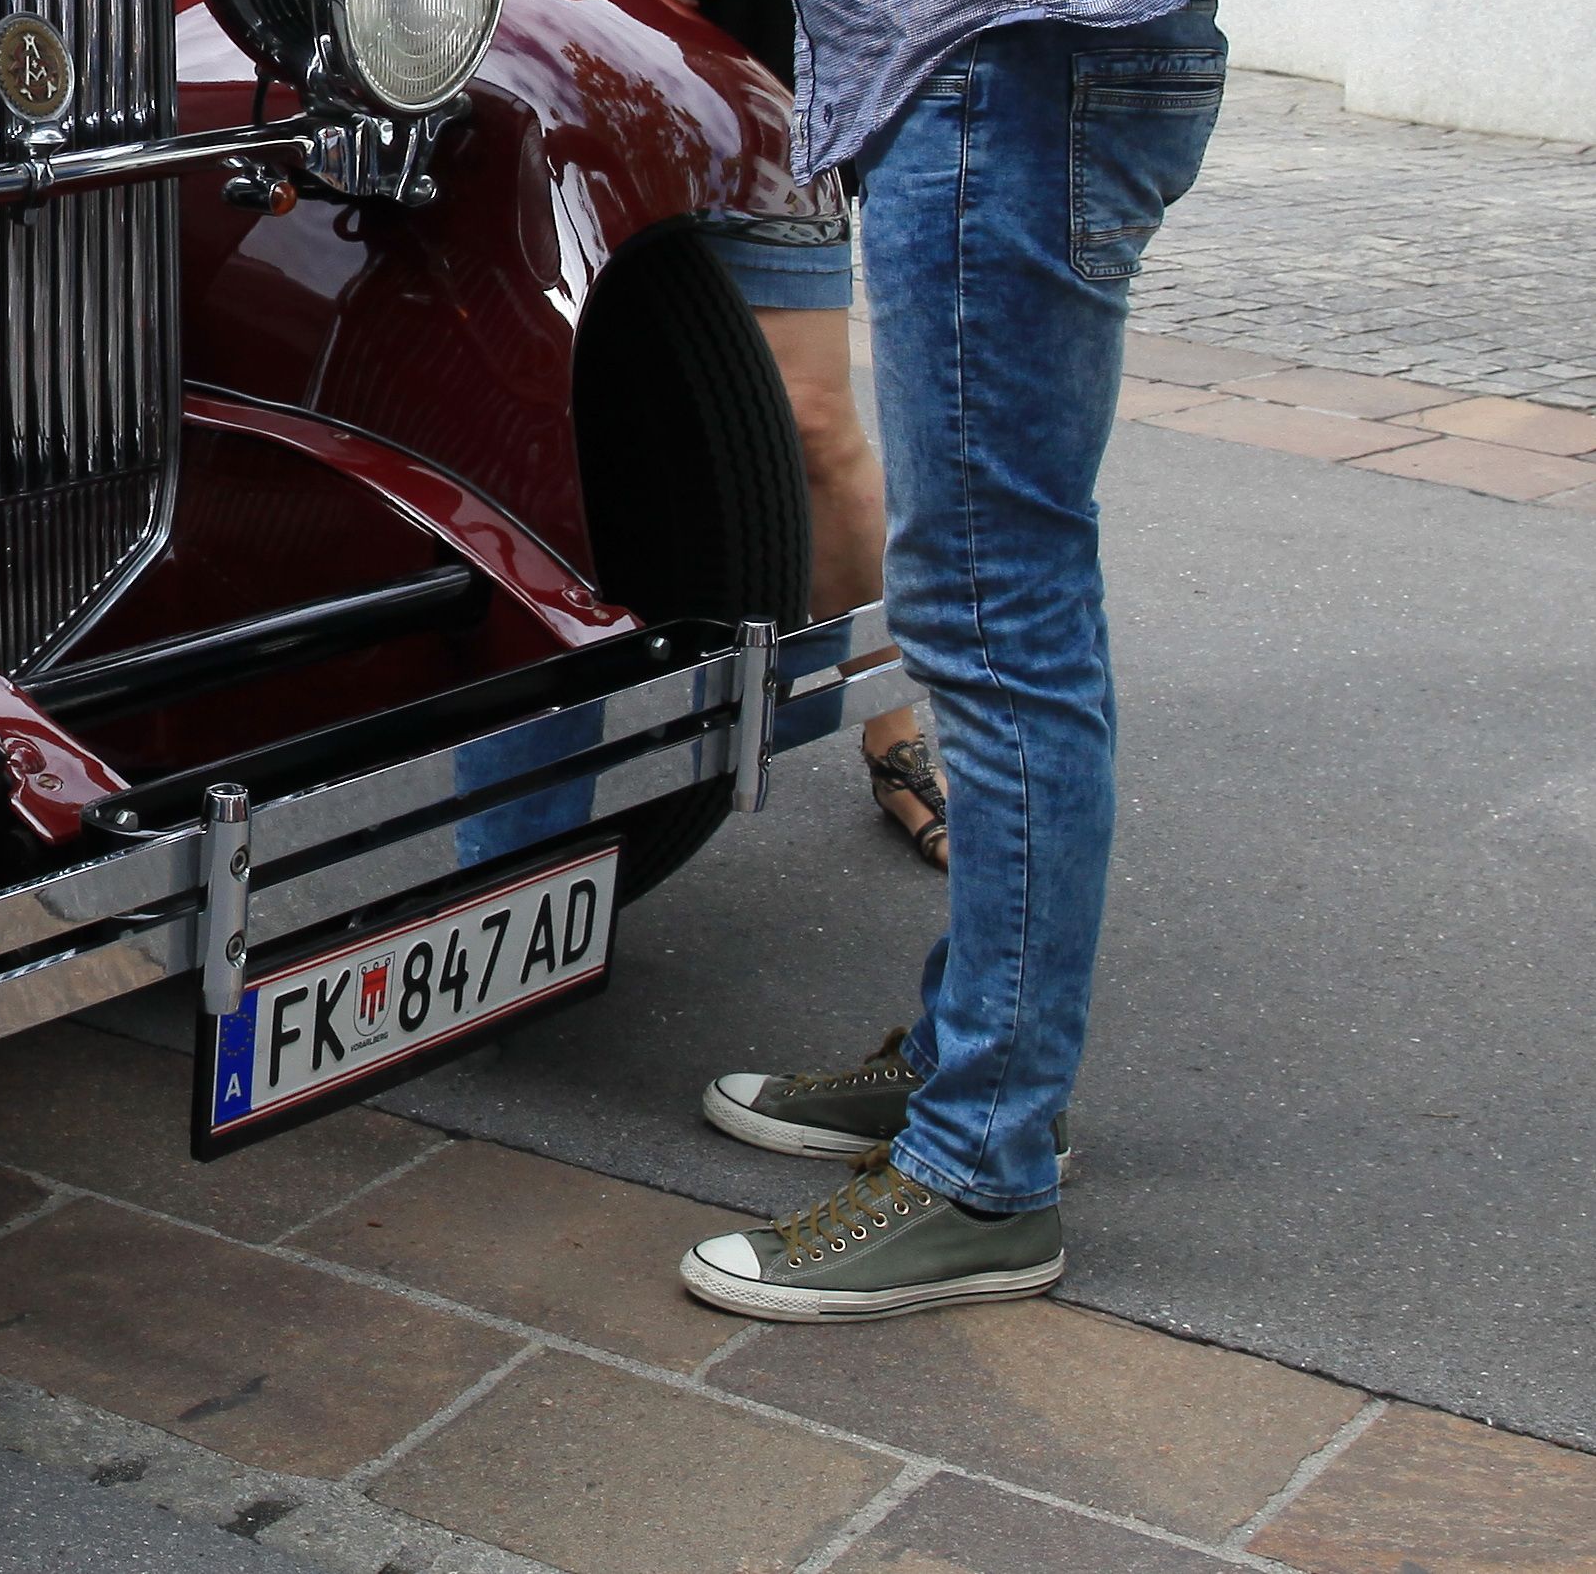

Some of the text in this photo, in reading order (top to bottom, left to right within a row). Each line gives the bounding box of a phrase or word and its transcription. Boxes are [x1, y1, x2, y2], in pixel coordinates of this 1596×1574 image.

[269, 878, 598, 1087] FK 847 AD
[350, 1031, 389, 1053] VORARLBERG
[224, 1072, 242, 1104] A
